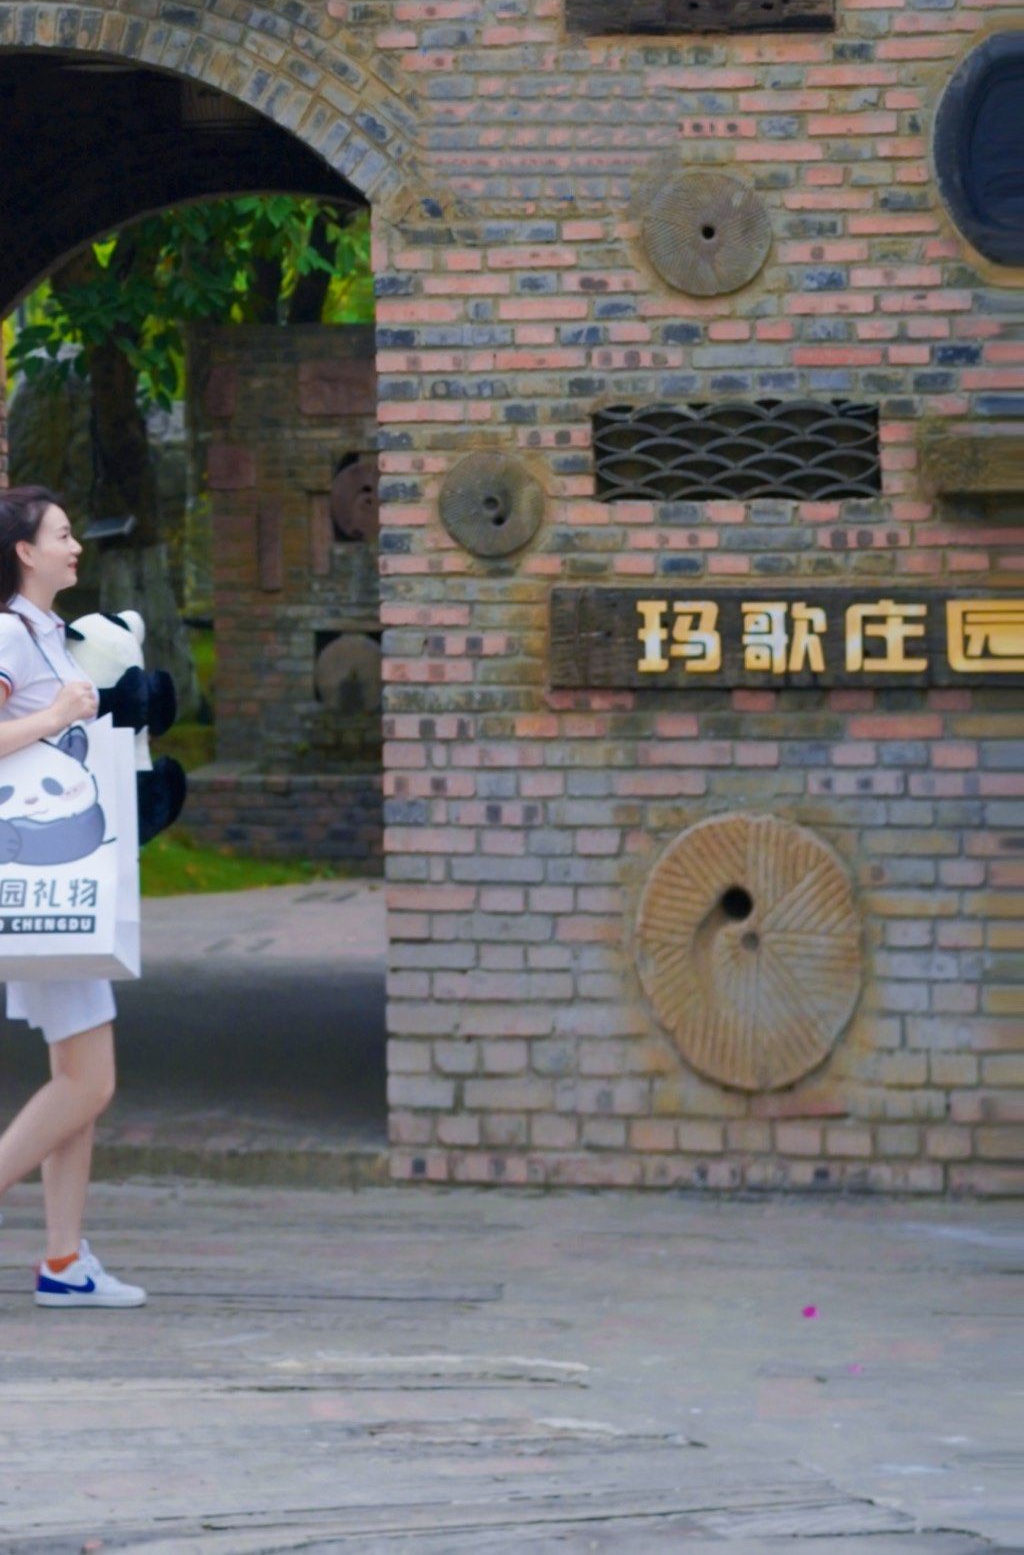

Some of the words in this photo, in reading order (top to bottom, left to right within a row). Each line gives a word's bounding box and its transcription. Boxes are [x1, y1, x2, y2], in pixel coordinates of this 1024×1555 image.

[636, 599, 1024, 673] 玛歌庄园
[11, 917, 91, 933] CHENGDU
